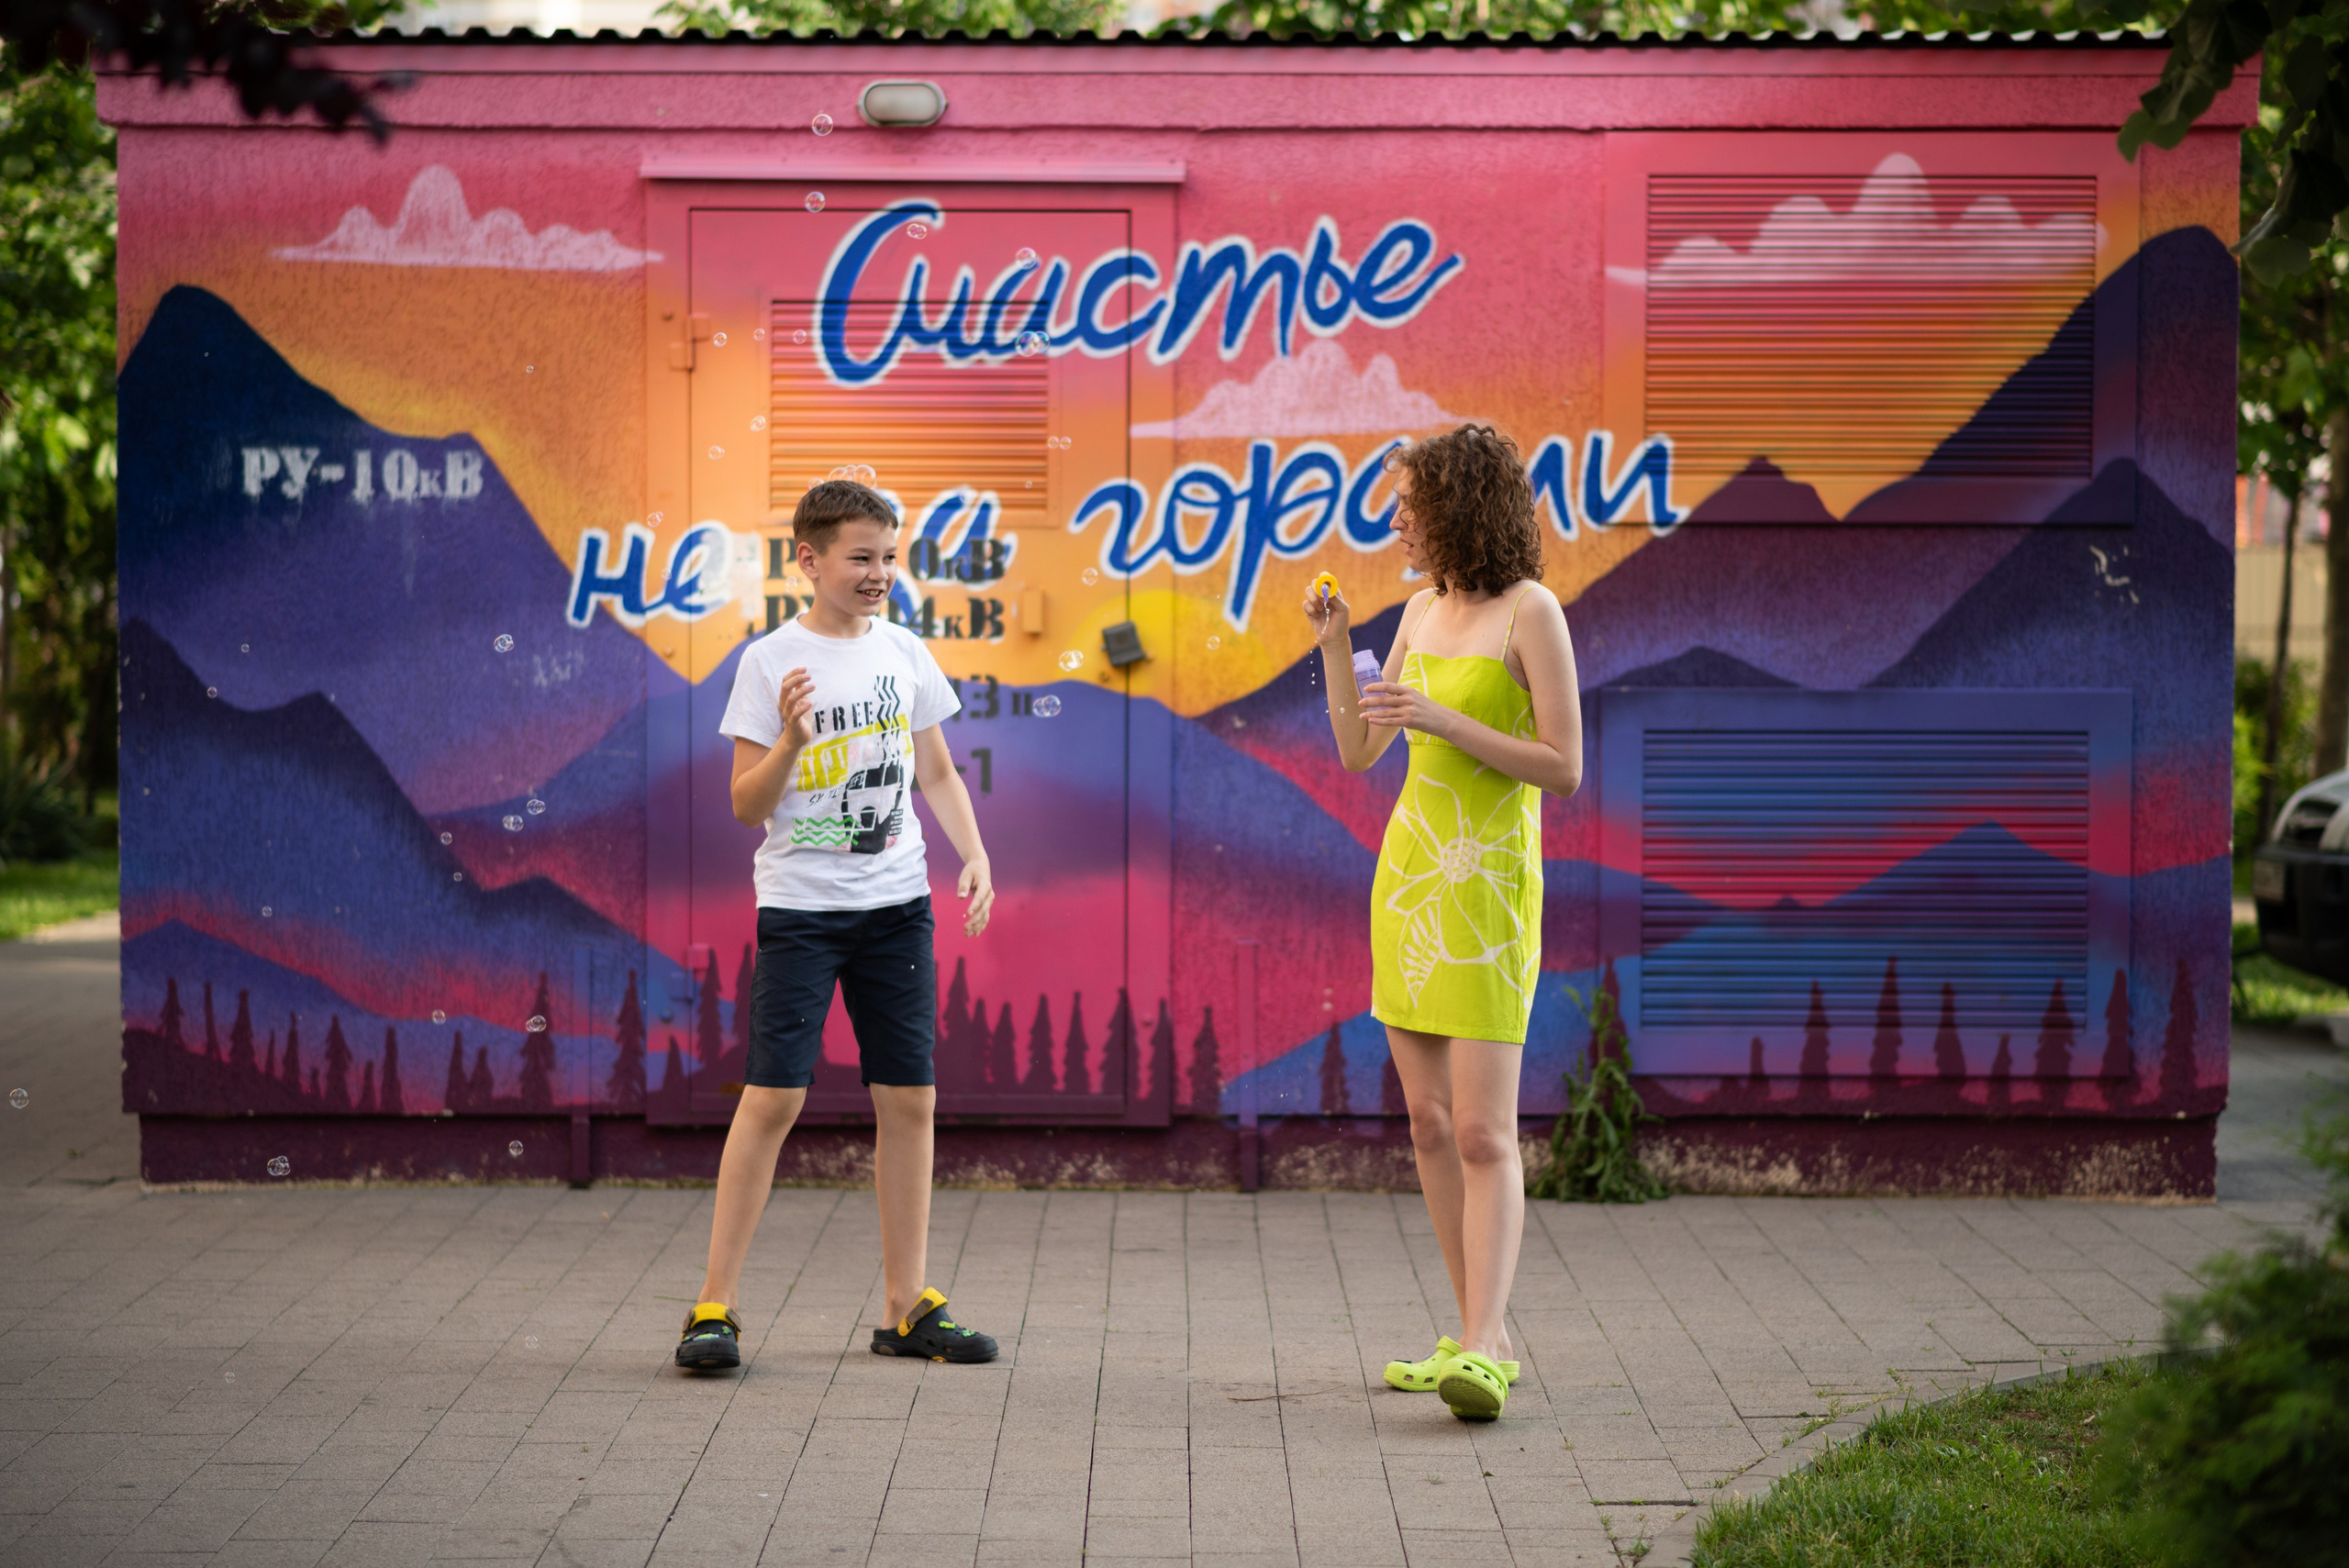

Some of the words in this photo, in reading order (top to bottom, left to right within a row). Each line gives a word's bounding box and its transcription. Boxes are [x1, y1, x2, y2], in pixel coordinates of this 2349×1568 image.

[813, 198, 1465, 385] Счастье
[241, 446, 484, 503] РУ-10кВ
[566, 519, 733, 628] не
[814, 701, 874, 734] FREE
